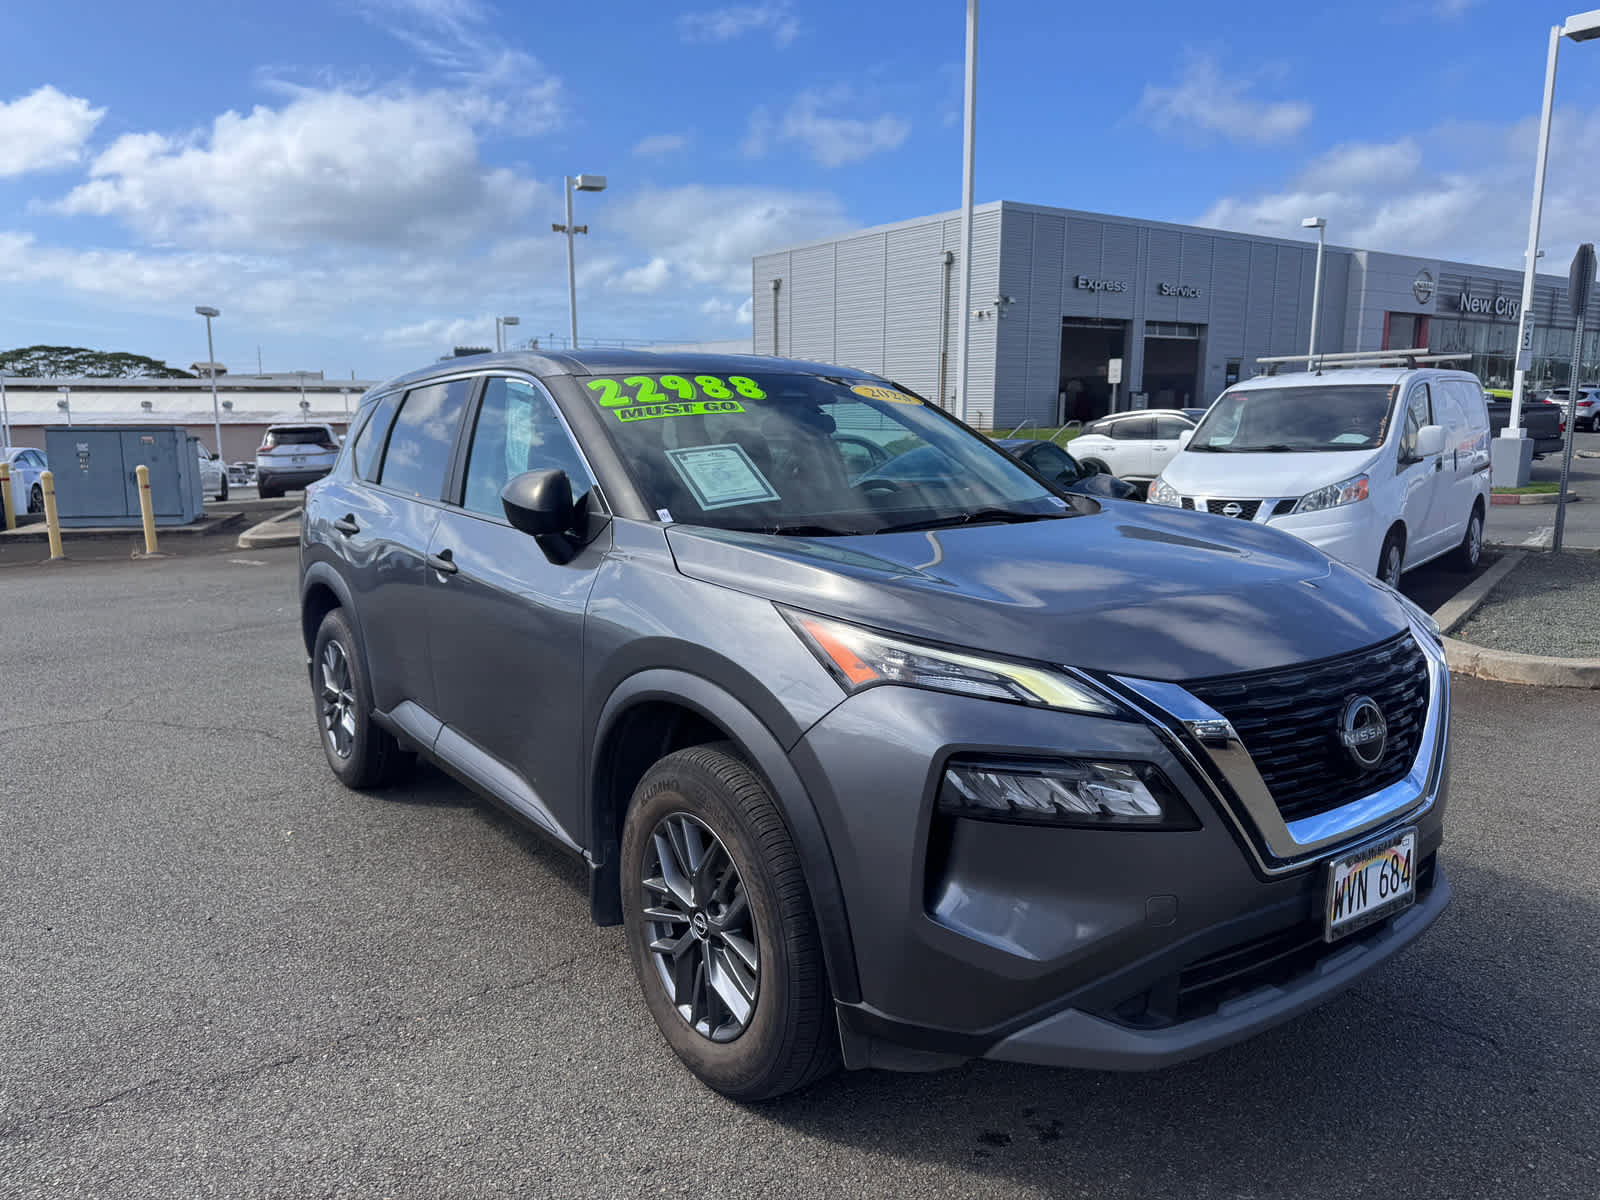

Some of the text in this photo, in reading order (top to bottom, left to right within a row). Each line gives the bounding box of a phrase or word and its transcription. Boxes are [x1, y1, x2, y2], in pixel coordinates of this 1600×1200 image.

[1075, 274, 1202, 299] Express Service
[1460, 293, 1520, 321] New City
[587, 375, 767, 407] 22988
[619, 402, 736, 420] MUST GO
[639, 778, 681, 808] KUMHO
[1332, 866, 1369, 921] WVN
[1379, 848, 1412, 900] 684
